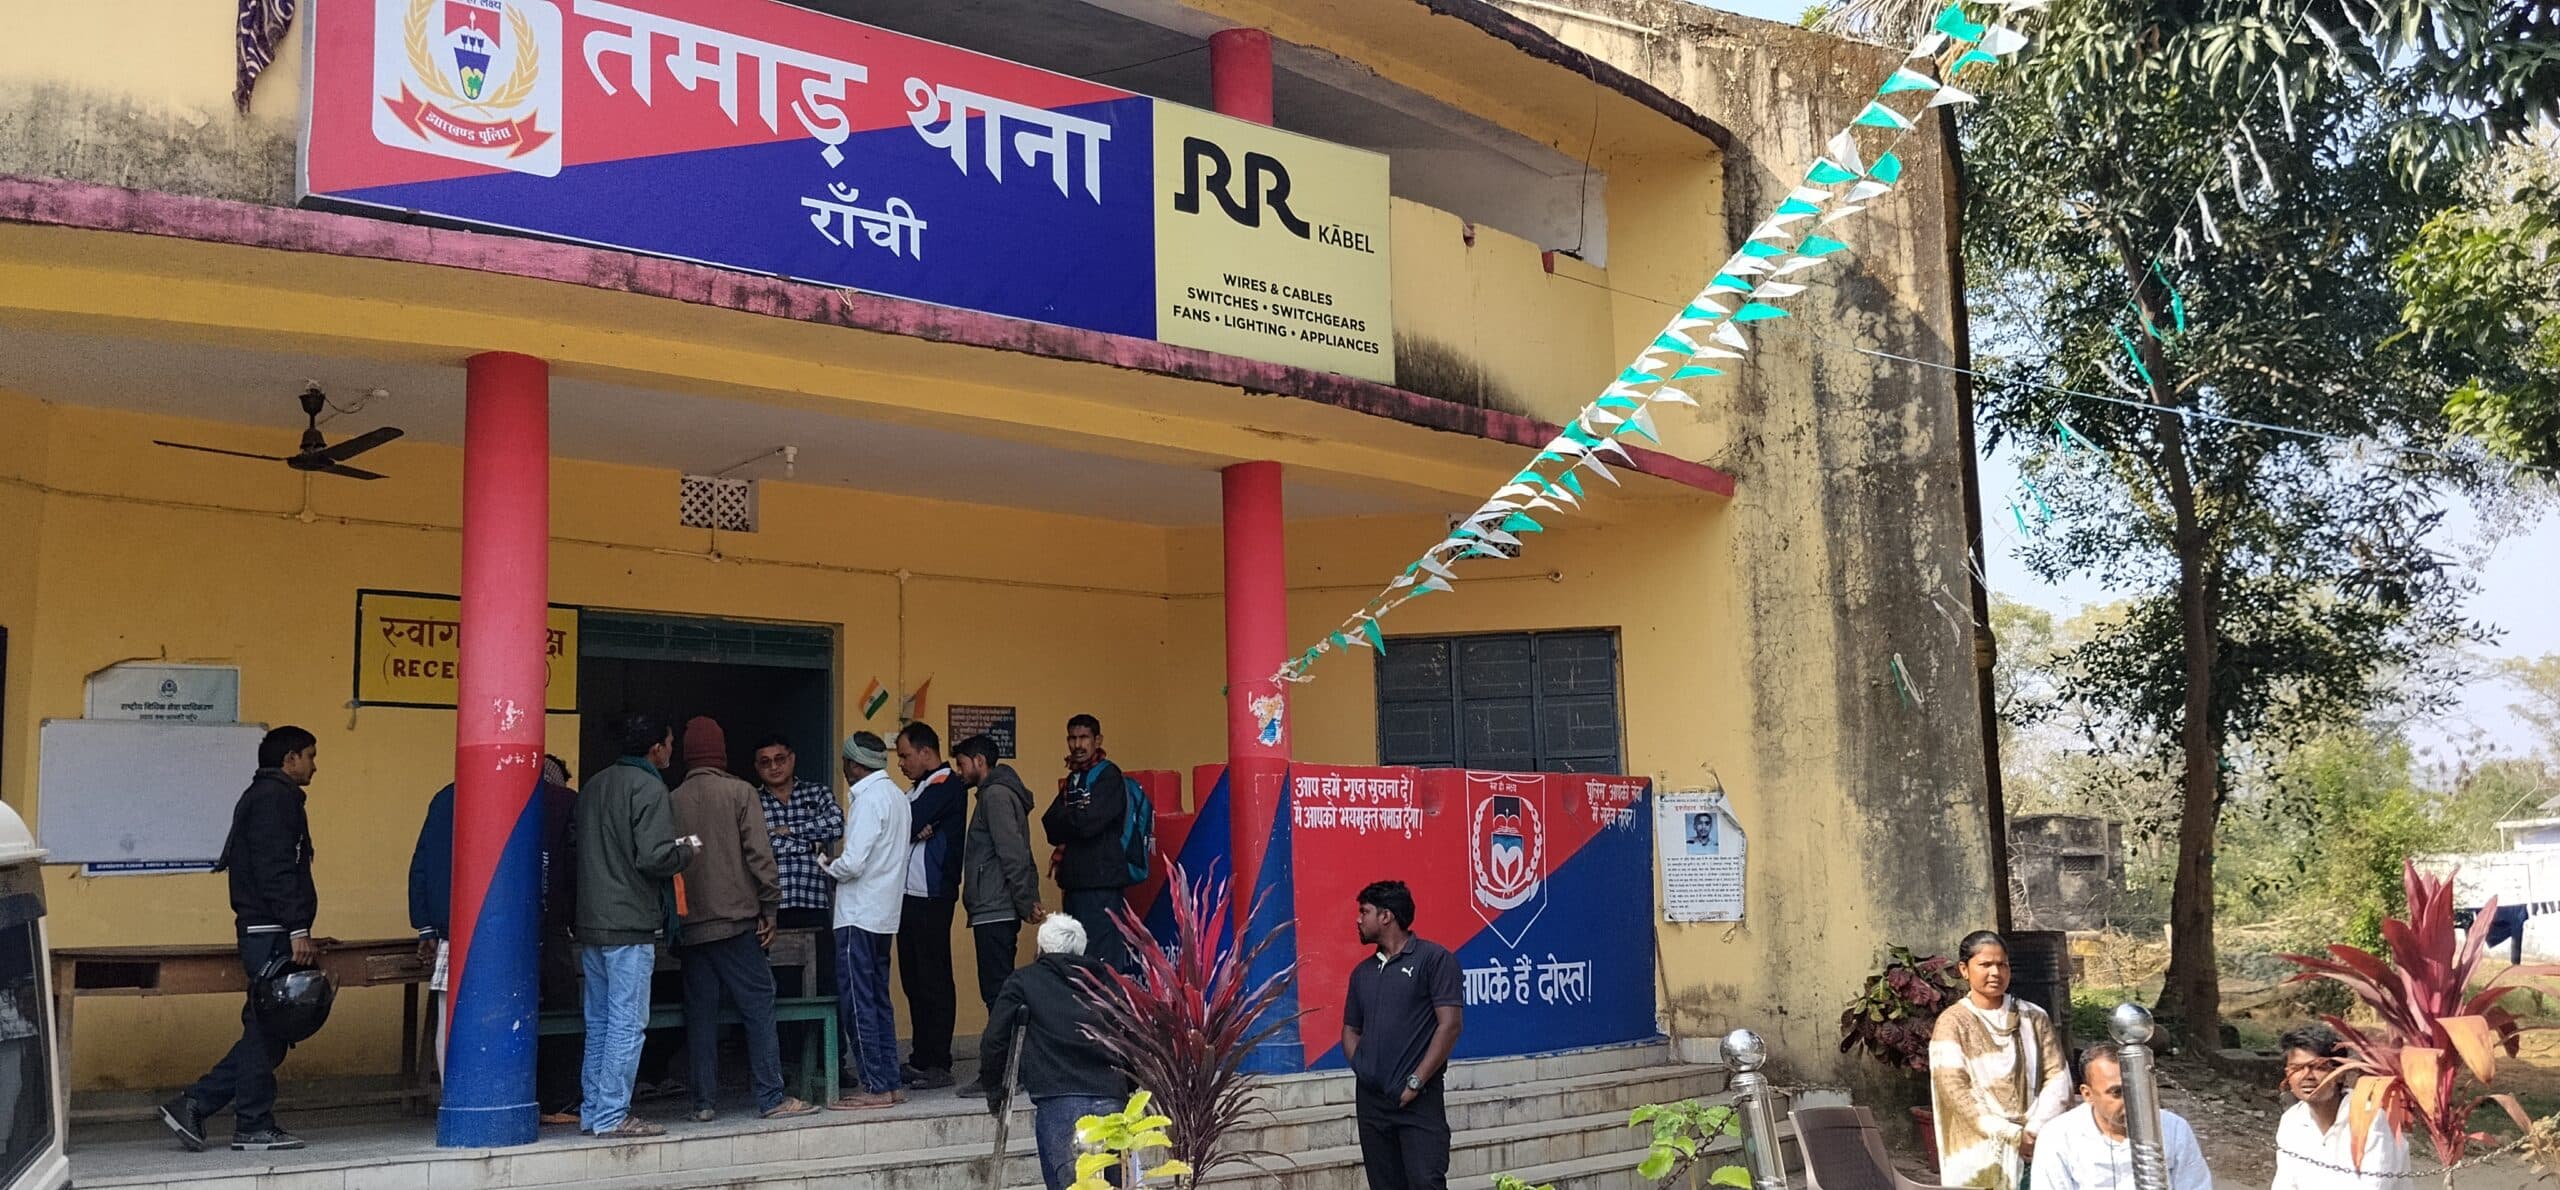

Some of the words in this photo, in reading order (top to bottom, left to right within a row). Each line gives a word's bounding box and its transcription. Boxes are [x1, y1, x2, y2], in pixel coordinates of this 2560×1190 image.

[573, 0, 868, 169] तमाड़
[903, 77, 1111, 205] थाना
[1174, 136, 1310, 240] RR
[801, 181, 927, 262] राँची
[1187, 287, 1259, 312] SWITCHES
[1271, 303, 1366, 332] SWITCHGEARS
[1223, 273, 1267, 293] WIRES
[1270, 283, 1280, 295] &
[1283, 285, 1333, 306] CABLES
[1173, 305, 1211, 323] FANS
[1224, 314, 1287, 337] LIGHTING
[1300, 330, 1380, 354] APPLIANCES
[1295, 776, 1320, 798] आप
[1321, 772, 1342, 801] हमें
[1303, 800, 1338, 829] आपको
[1339, 806, 1378, 836] भयमुक्त
[1379, 807, 1403, 831] समाज
[1512, 953, 1533, 1005] हैं
